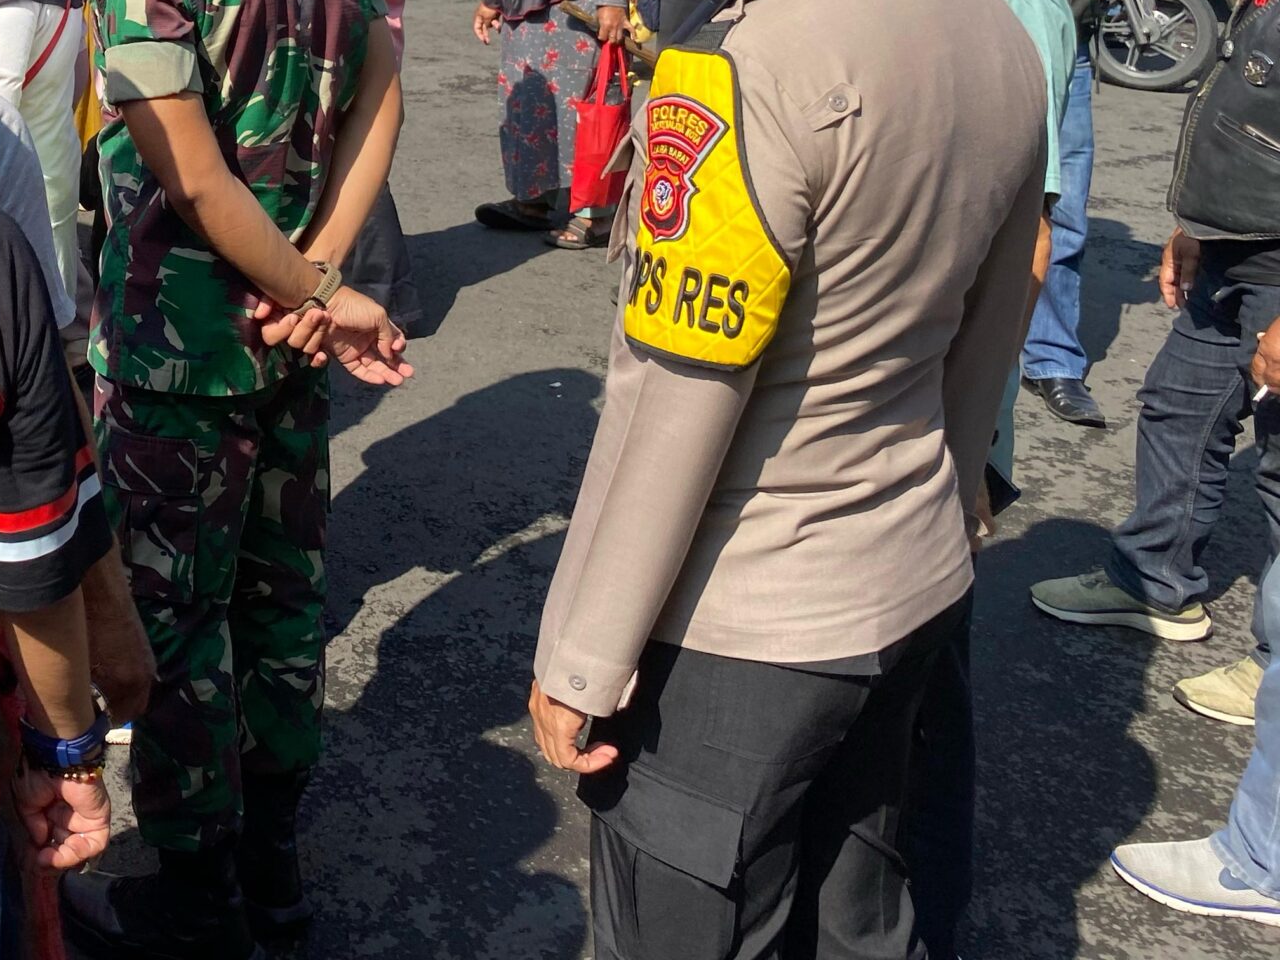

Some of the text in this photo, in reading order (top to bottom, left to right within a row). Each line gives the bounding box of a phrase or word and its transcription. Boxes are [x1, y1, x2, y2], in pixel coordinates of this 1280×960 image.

[652, 104, 709, 136] POLRES
[629, 246, 749, 340] PS RES
